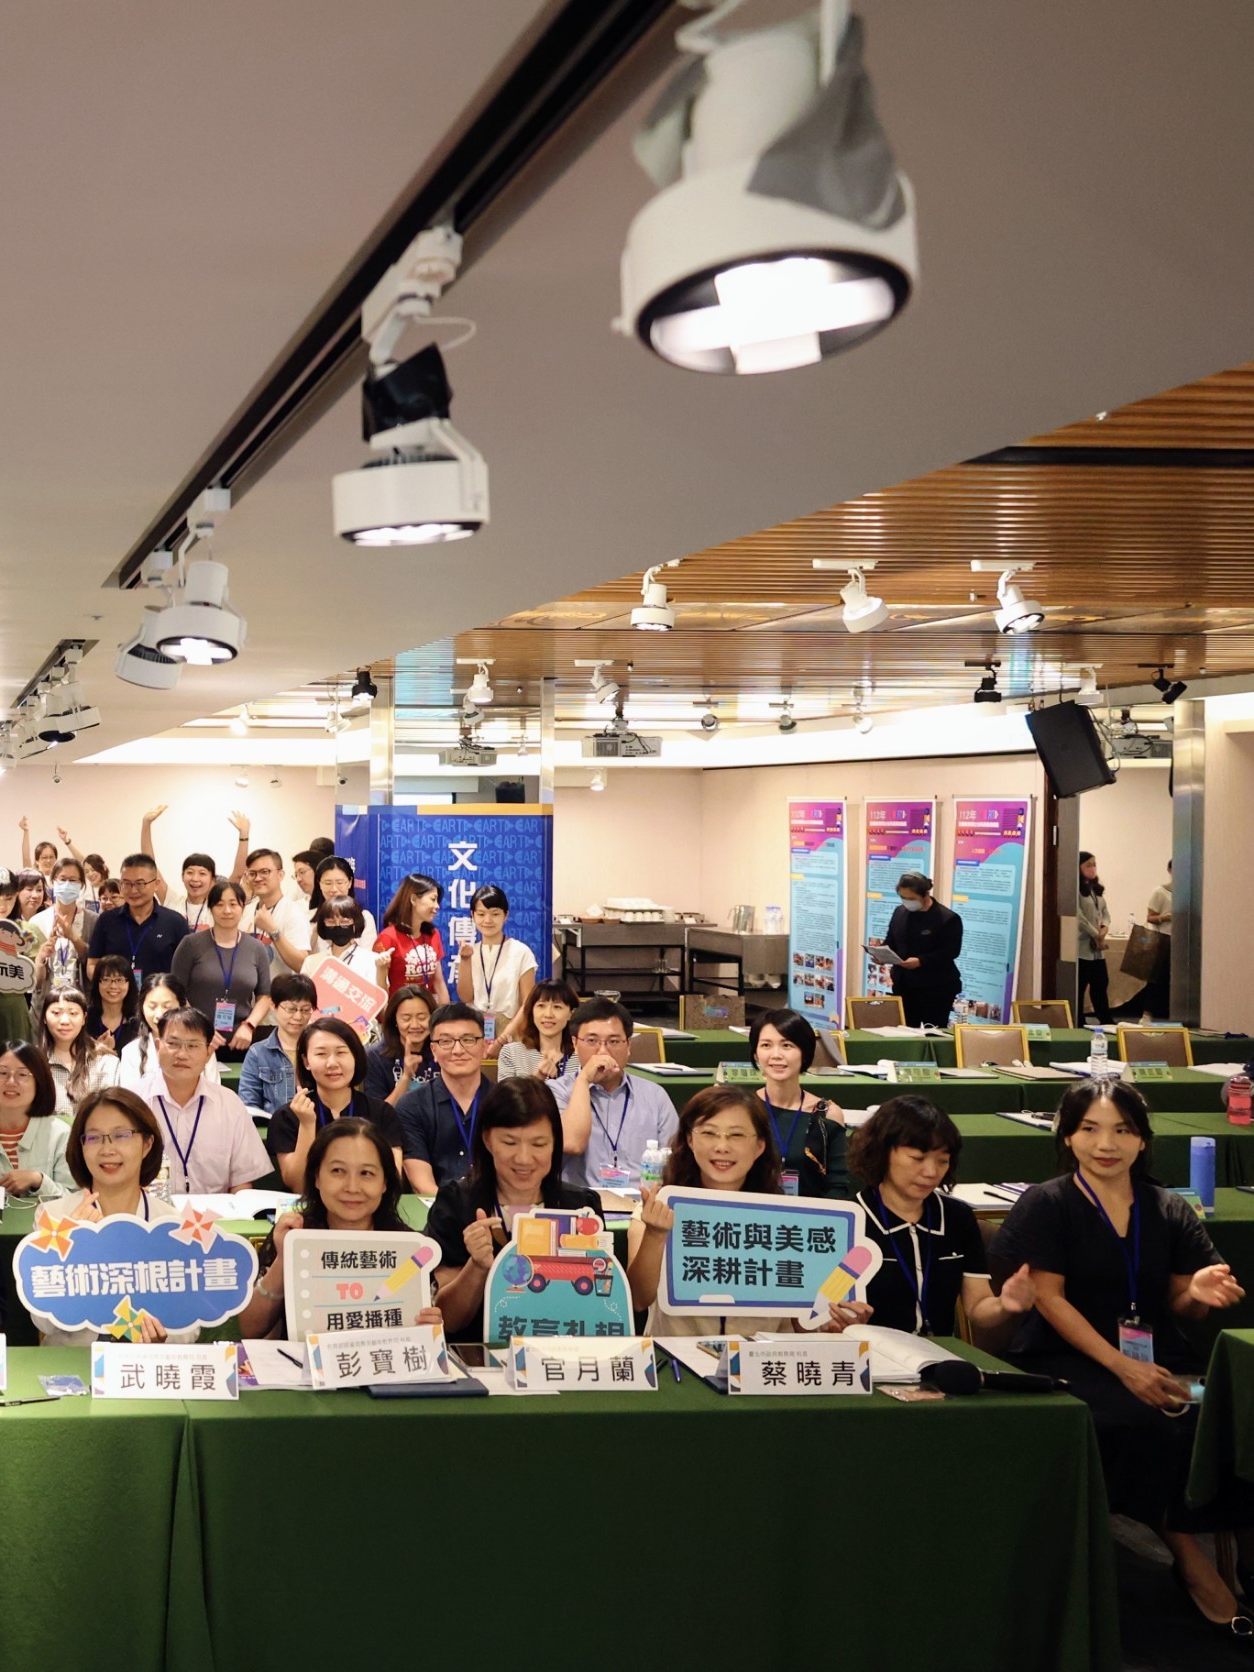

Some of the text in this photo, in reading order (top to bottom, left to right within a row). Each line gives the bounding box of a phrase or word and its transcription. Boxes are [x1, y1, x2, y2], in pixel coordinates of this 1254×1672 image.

[681, 1219, 836, 1254] 藝術與美感
[321, 1250, 397, 1269] 傳統藝術
[682, 1255, 805, 1288] 深耕計畫
[31, 1258, 239, 1298] 藝術深根計畫
[336, 1282, 363, 1300] TO
[327, 1308, 403, 1331] 用愛播種
[336, 1344, 430, 1379] 彭寶樹
[541, 1355, 635, 1383] 官月蘭
[761, 1360, 856, 1386] 蔡曉青
[120, 1363, 216, 1391] 武曉霞
